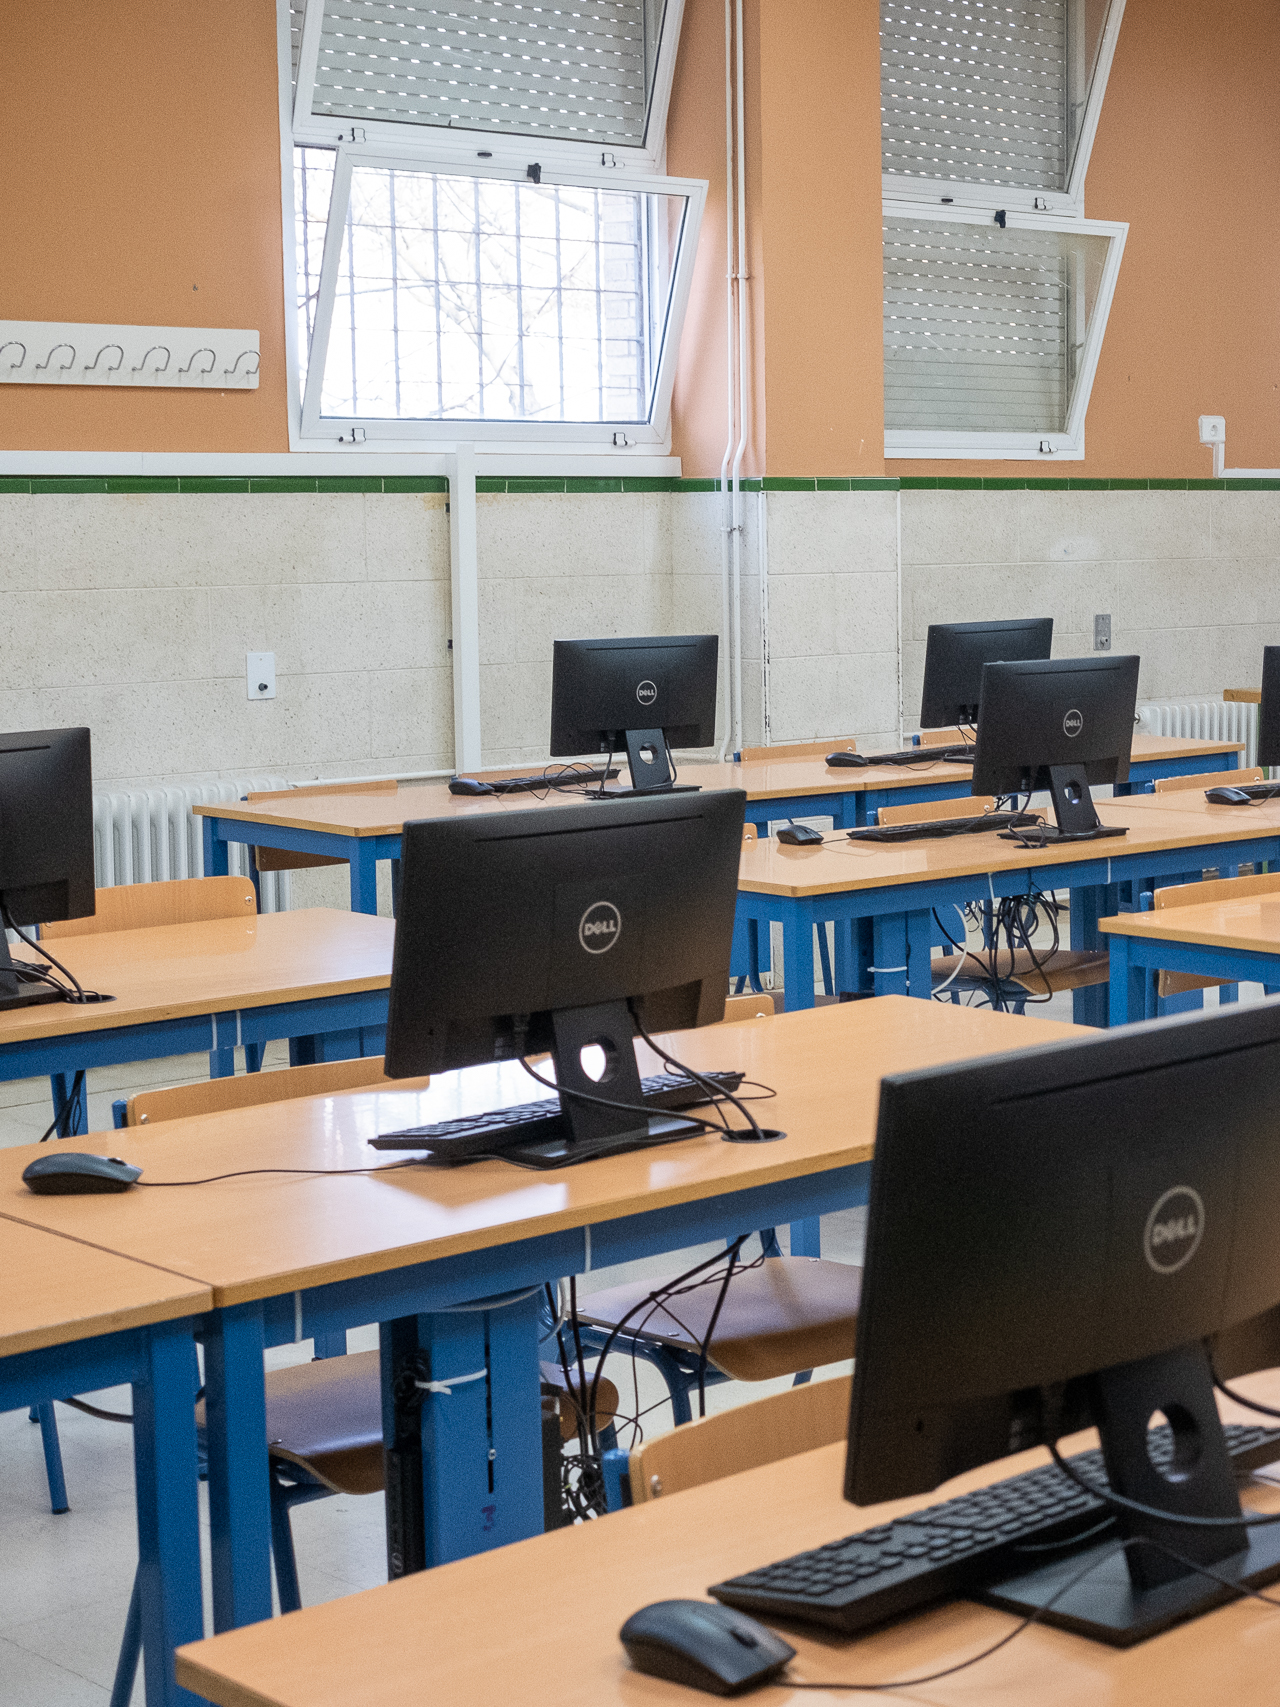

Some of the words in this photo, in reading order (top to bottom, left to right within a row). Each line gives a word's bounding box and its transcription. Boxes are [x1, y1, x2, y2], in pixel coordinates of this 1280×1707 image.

[639, 689, 654, 697] DELL
[1065, 719, 1081, 727] DELL
[584, 921, 617, 936] DELL
[1152, 1216, 1196, 1246] DELL
